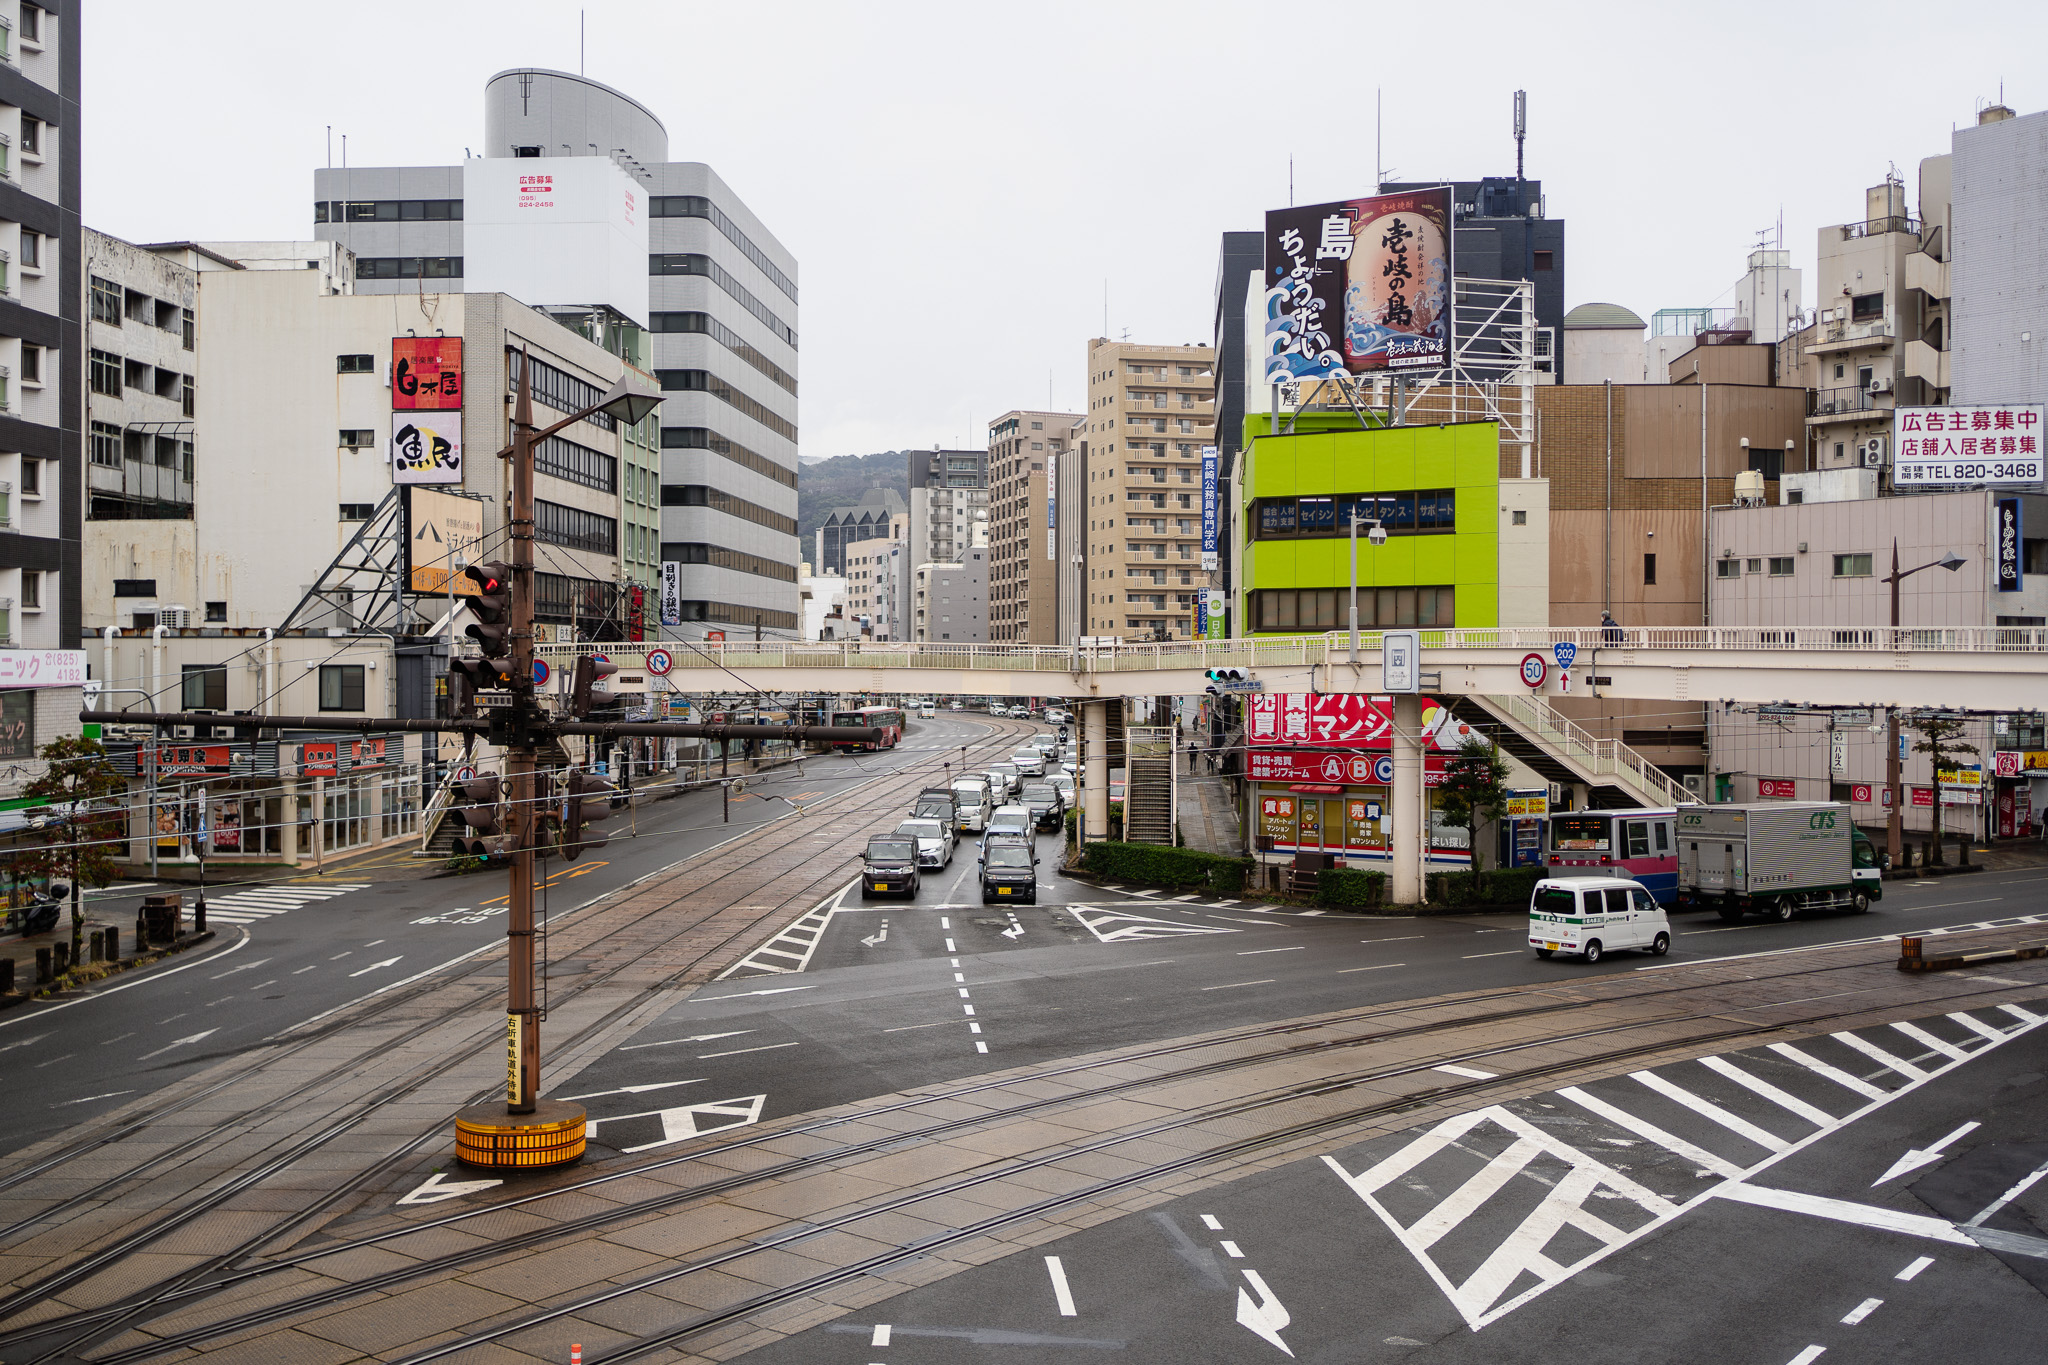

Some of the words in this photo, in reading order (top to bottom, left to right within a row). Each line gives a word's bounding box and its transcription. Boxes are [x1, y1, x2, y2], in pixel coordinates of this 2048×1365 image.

[520, 176, 553, 184] 広告募集
[1382, 218, 1413, 326] 壱岐の島
[397, 357, 458, 396] 白木屋
[1902, 410, 2037, 432] 広告主募集中
[395, 424, 459, 471] 魚民
[1901, 436, 2036, 456] 店舗入居者募集
[1927, 466, 1951, 479] TEL
[1954, 464, 2037, 479] 820-3468
[1205, 460, 1215, 550] 長崎公務員専門学校
[1281, 507, 1295, 515] 人材
[1263, 518, 1278, 527] 能力
[2002, 509, 2016, 561] らーめん家
[665, 564, 677, 618] 目利きの銀次
[1557, 649, 1573, 659] 202
[1, 655, 40, 679] ニック
[53, 653, 78, 666] (825)
[1526, 663, 1541, 678] 50
[57, 669, 80, 681] 4182
[161, 749, 206, 763] 吉野家
[307, 751, 333, 760] 吉野家
[1252, 755, 1292, 766] 賃貸・売買
[1252, 766, 1310, 778] 建築・リフォーム
[1264, 800, 1291, 814] 賃貸
[1351, 804, 1380, 818] 売買
[1684, 815, 1702, 824] CTS
[1810, 811, 1836, 830] CTS
[409, 916, 488, 924] 16-19
